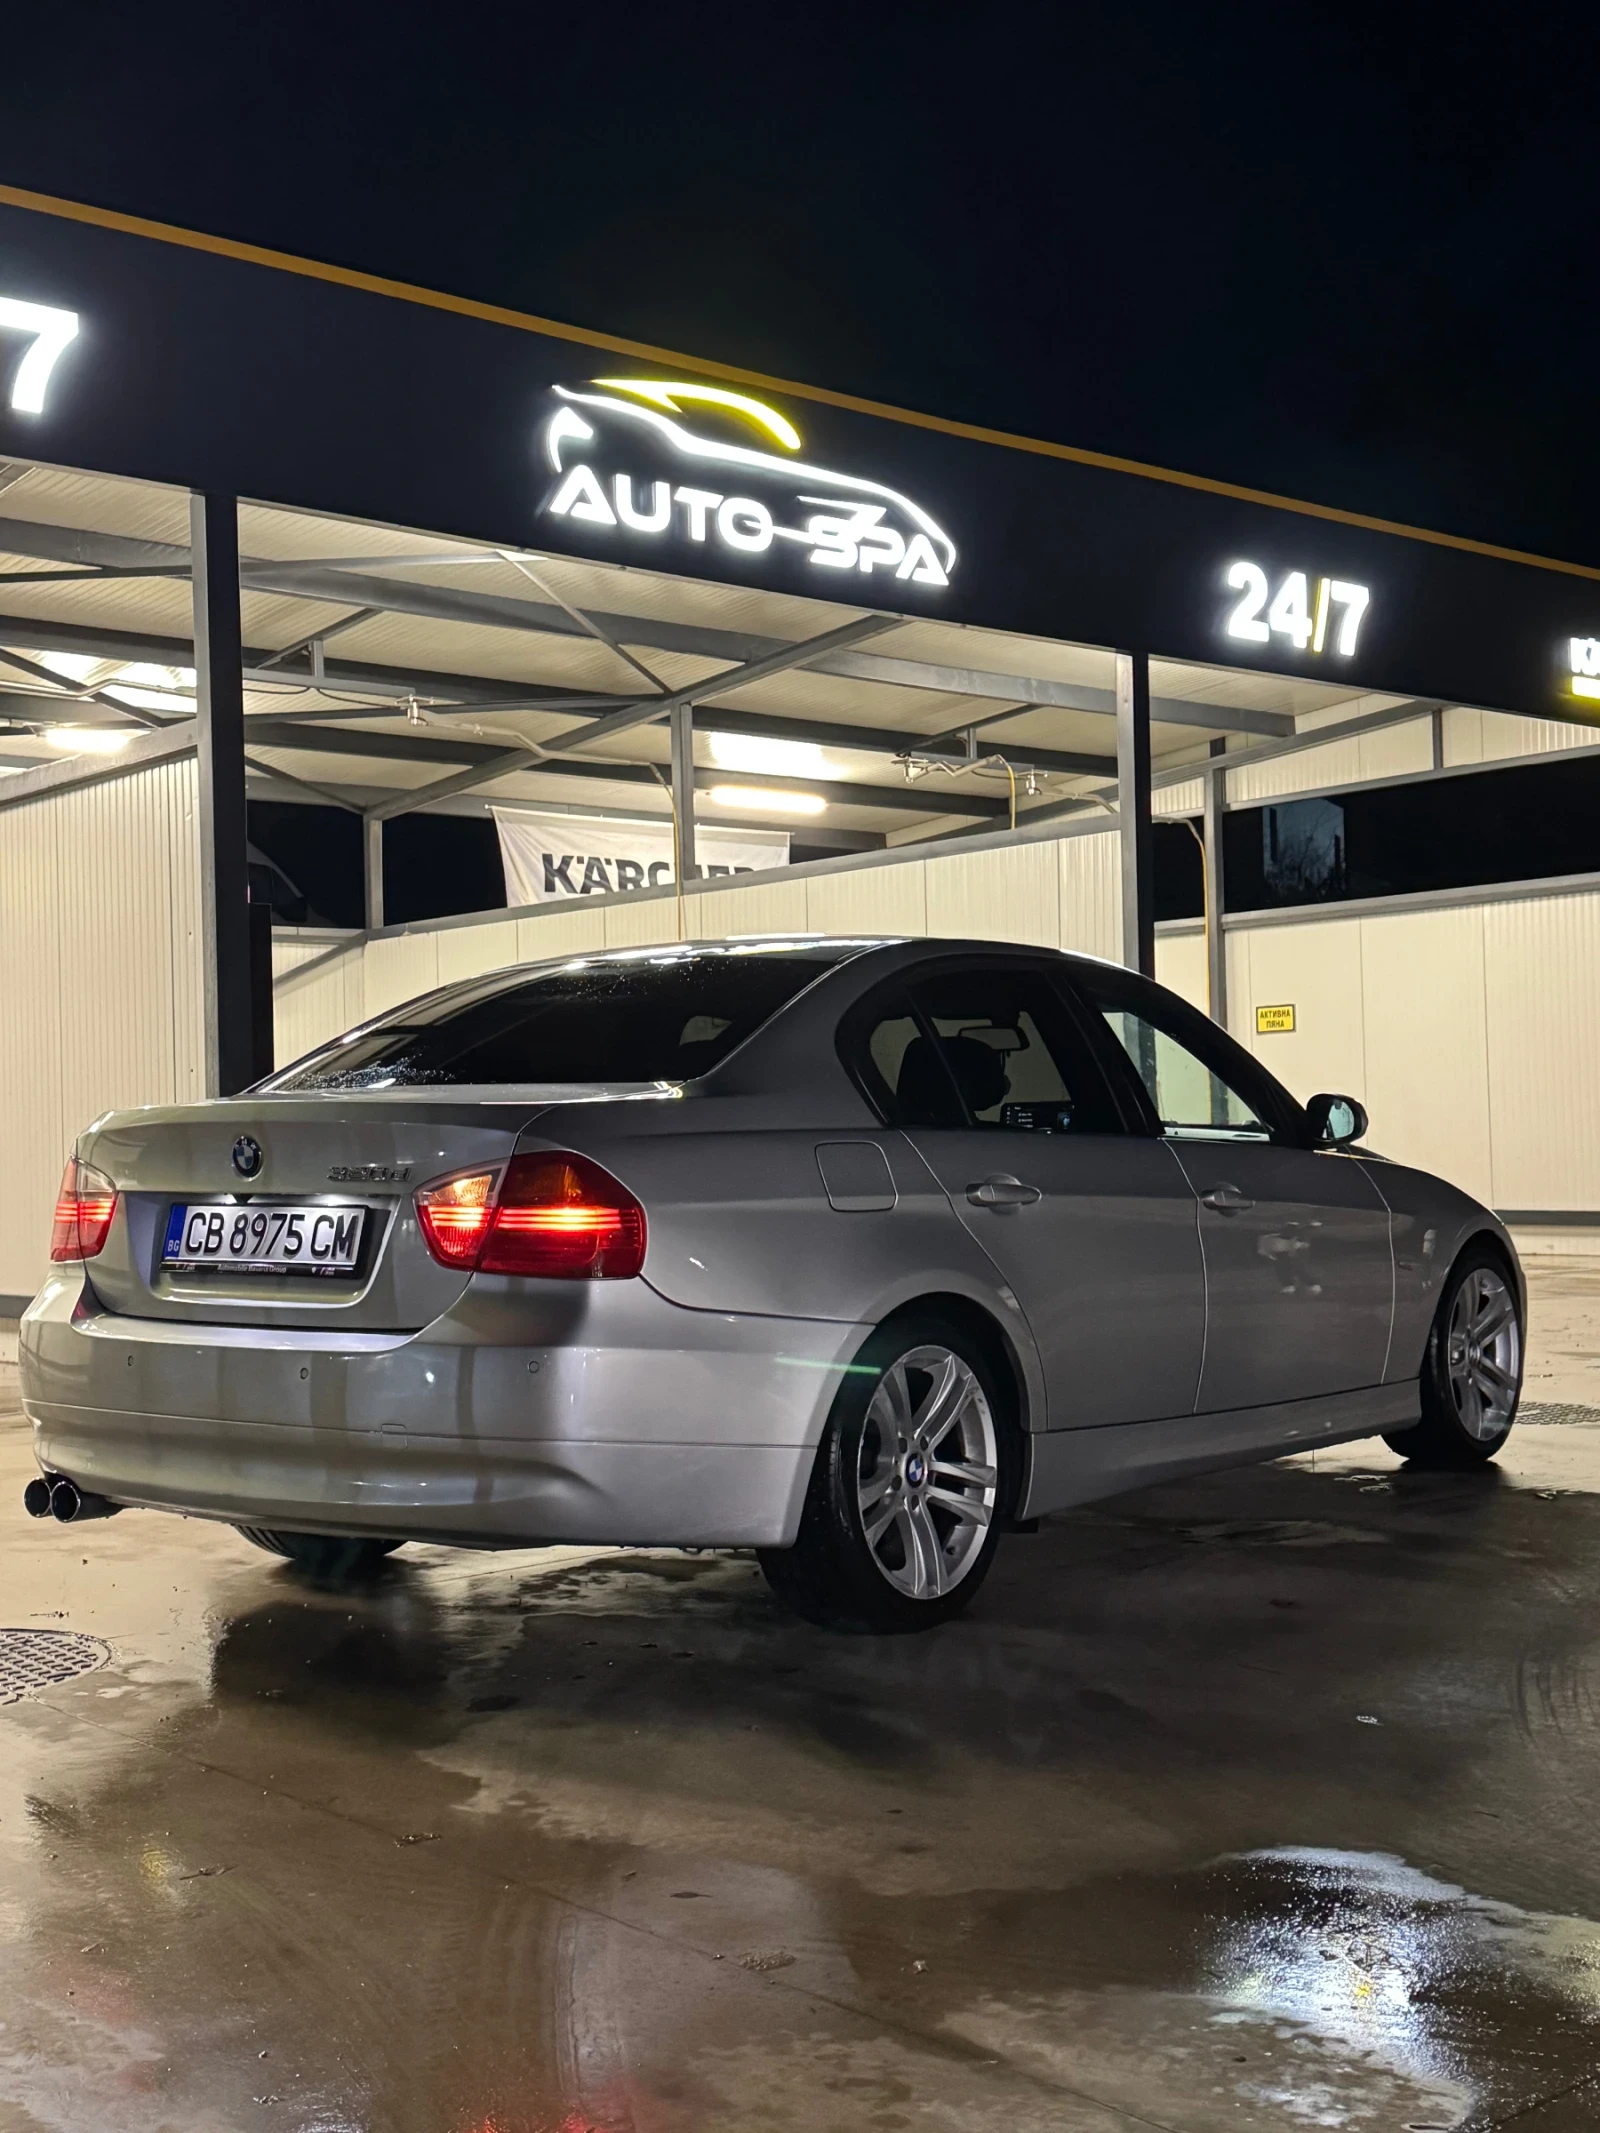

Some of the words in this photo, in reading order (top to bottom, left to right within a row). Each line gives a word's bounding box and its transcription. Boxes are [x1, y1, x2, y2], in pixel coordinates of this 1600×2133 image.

[549, 465, 773, 552] AUTO
[799, 497, 950, 586] SPA
[1259, 1008, 1291, 1019] АКТИВНА
[1266, 1019, 1285, 1029] ПЯНА
[186, 1212, 224, 1254] CB
[230, 1213, 306, 1257] 8975
[311, 1214, 359, 1259] CM
[167, 1240, 181, 1253] BG
